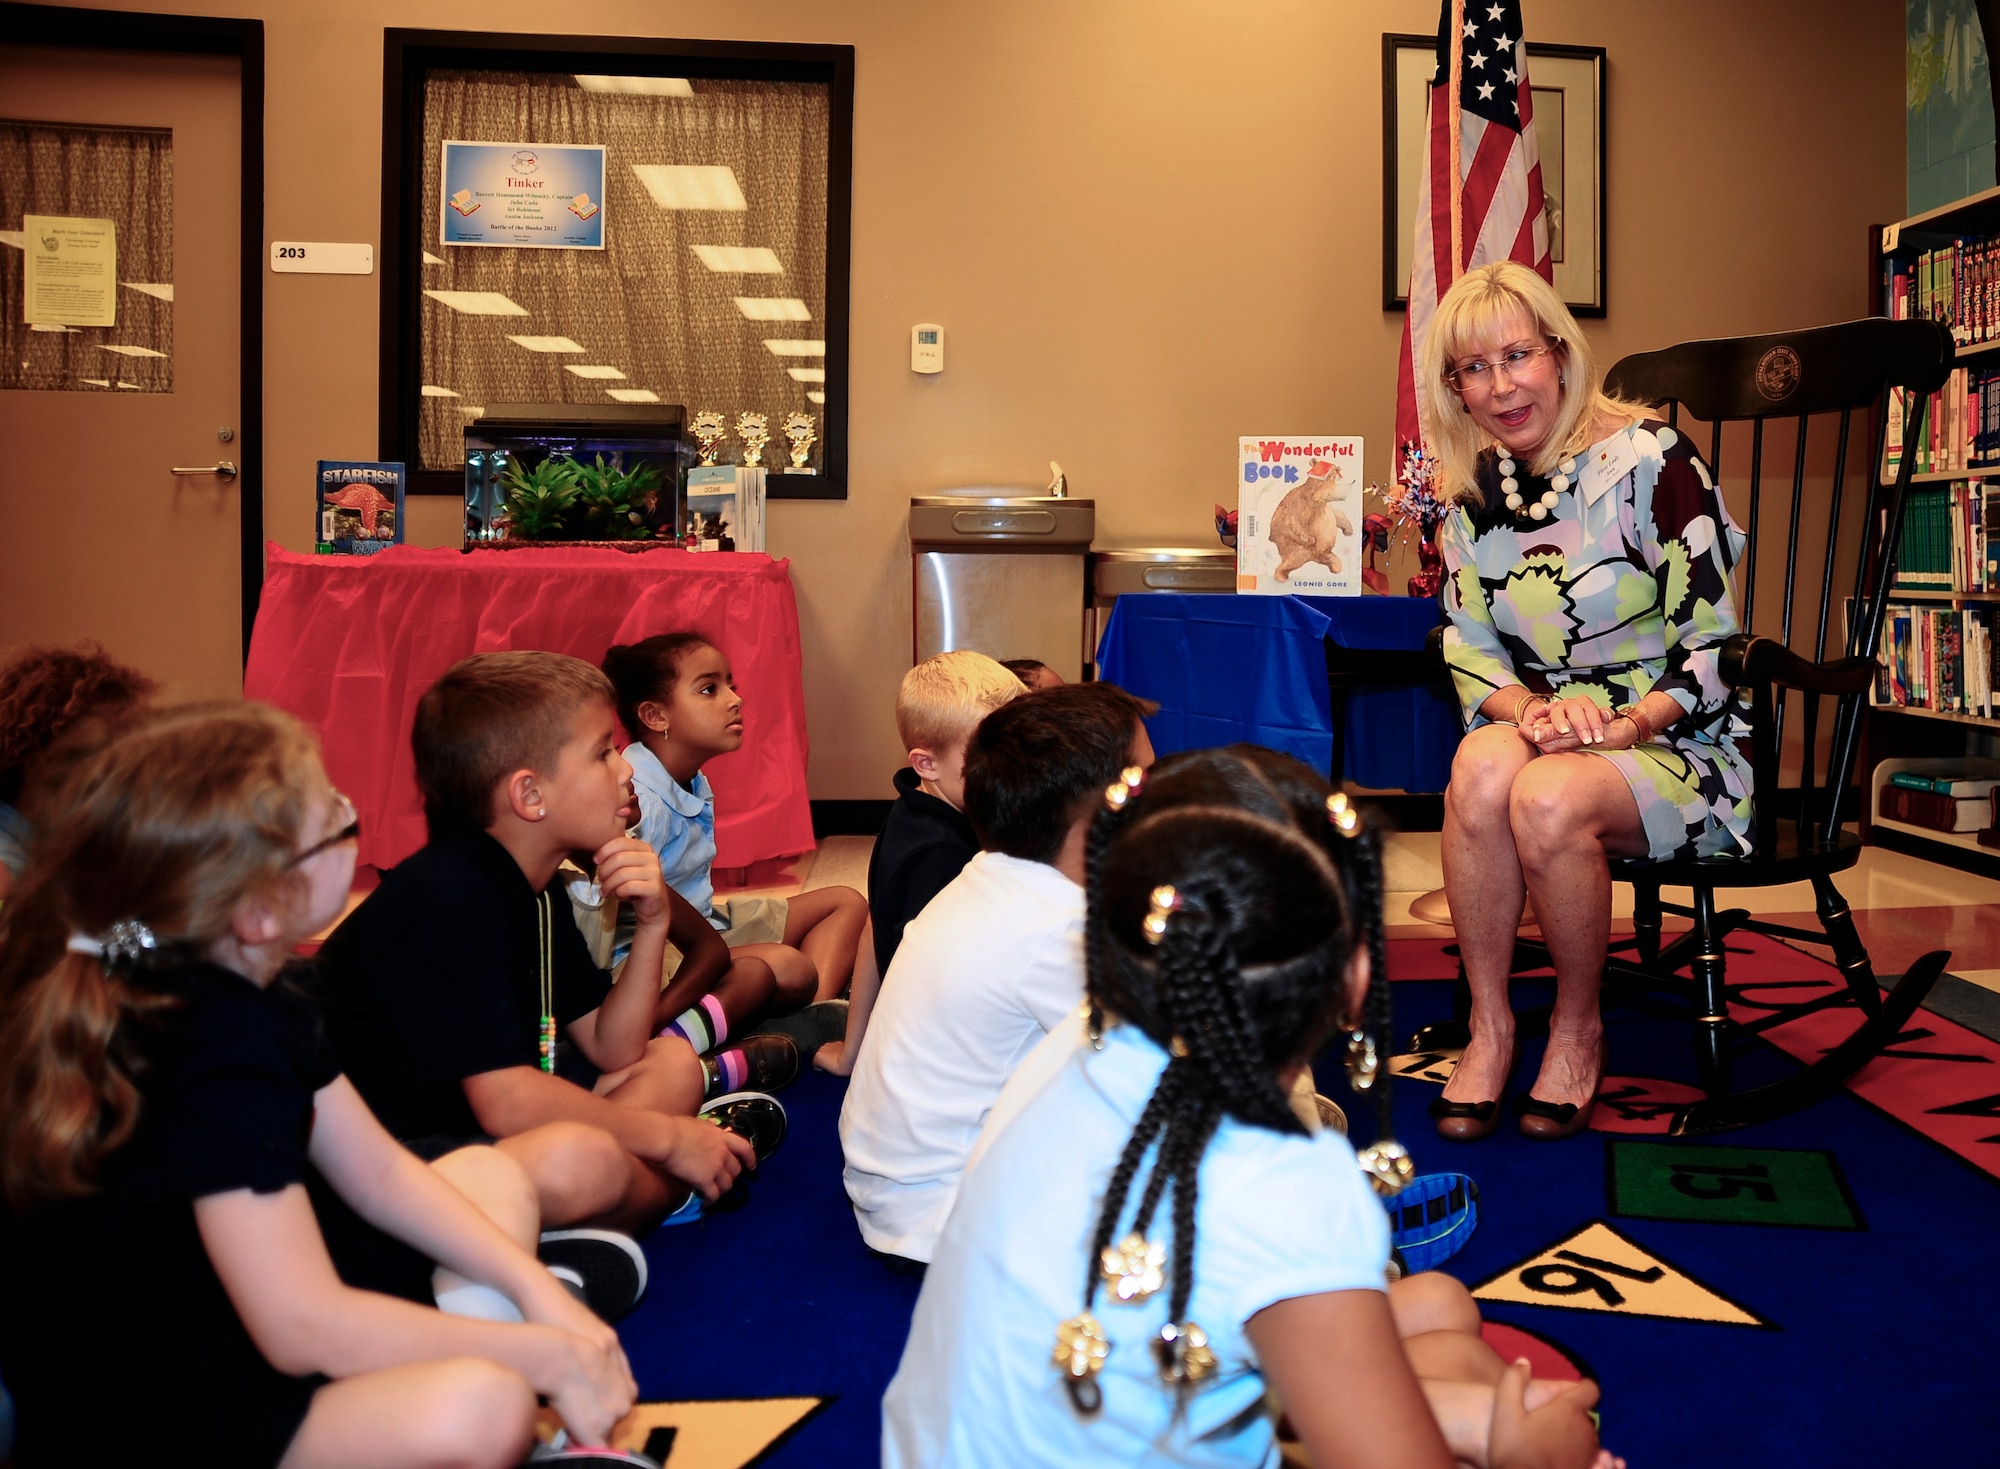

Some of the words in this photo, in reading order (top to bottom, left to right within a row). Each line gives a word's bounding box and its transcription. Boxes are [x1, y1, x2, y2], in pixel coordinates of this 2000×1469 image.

[505, 177, 544, 189] Tinker
[279, 247, 306, 259] 203
[1243, 443, 1264, 455] The
[1258, 441, 1354, 463] Wonderful
[322, 468, 399, 485] STARFISH
[1669, 1163, 1778, 1203] 15
[1519, 1249, 1666, 1307] 16
